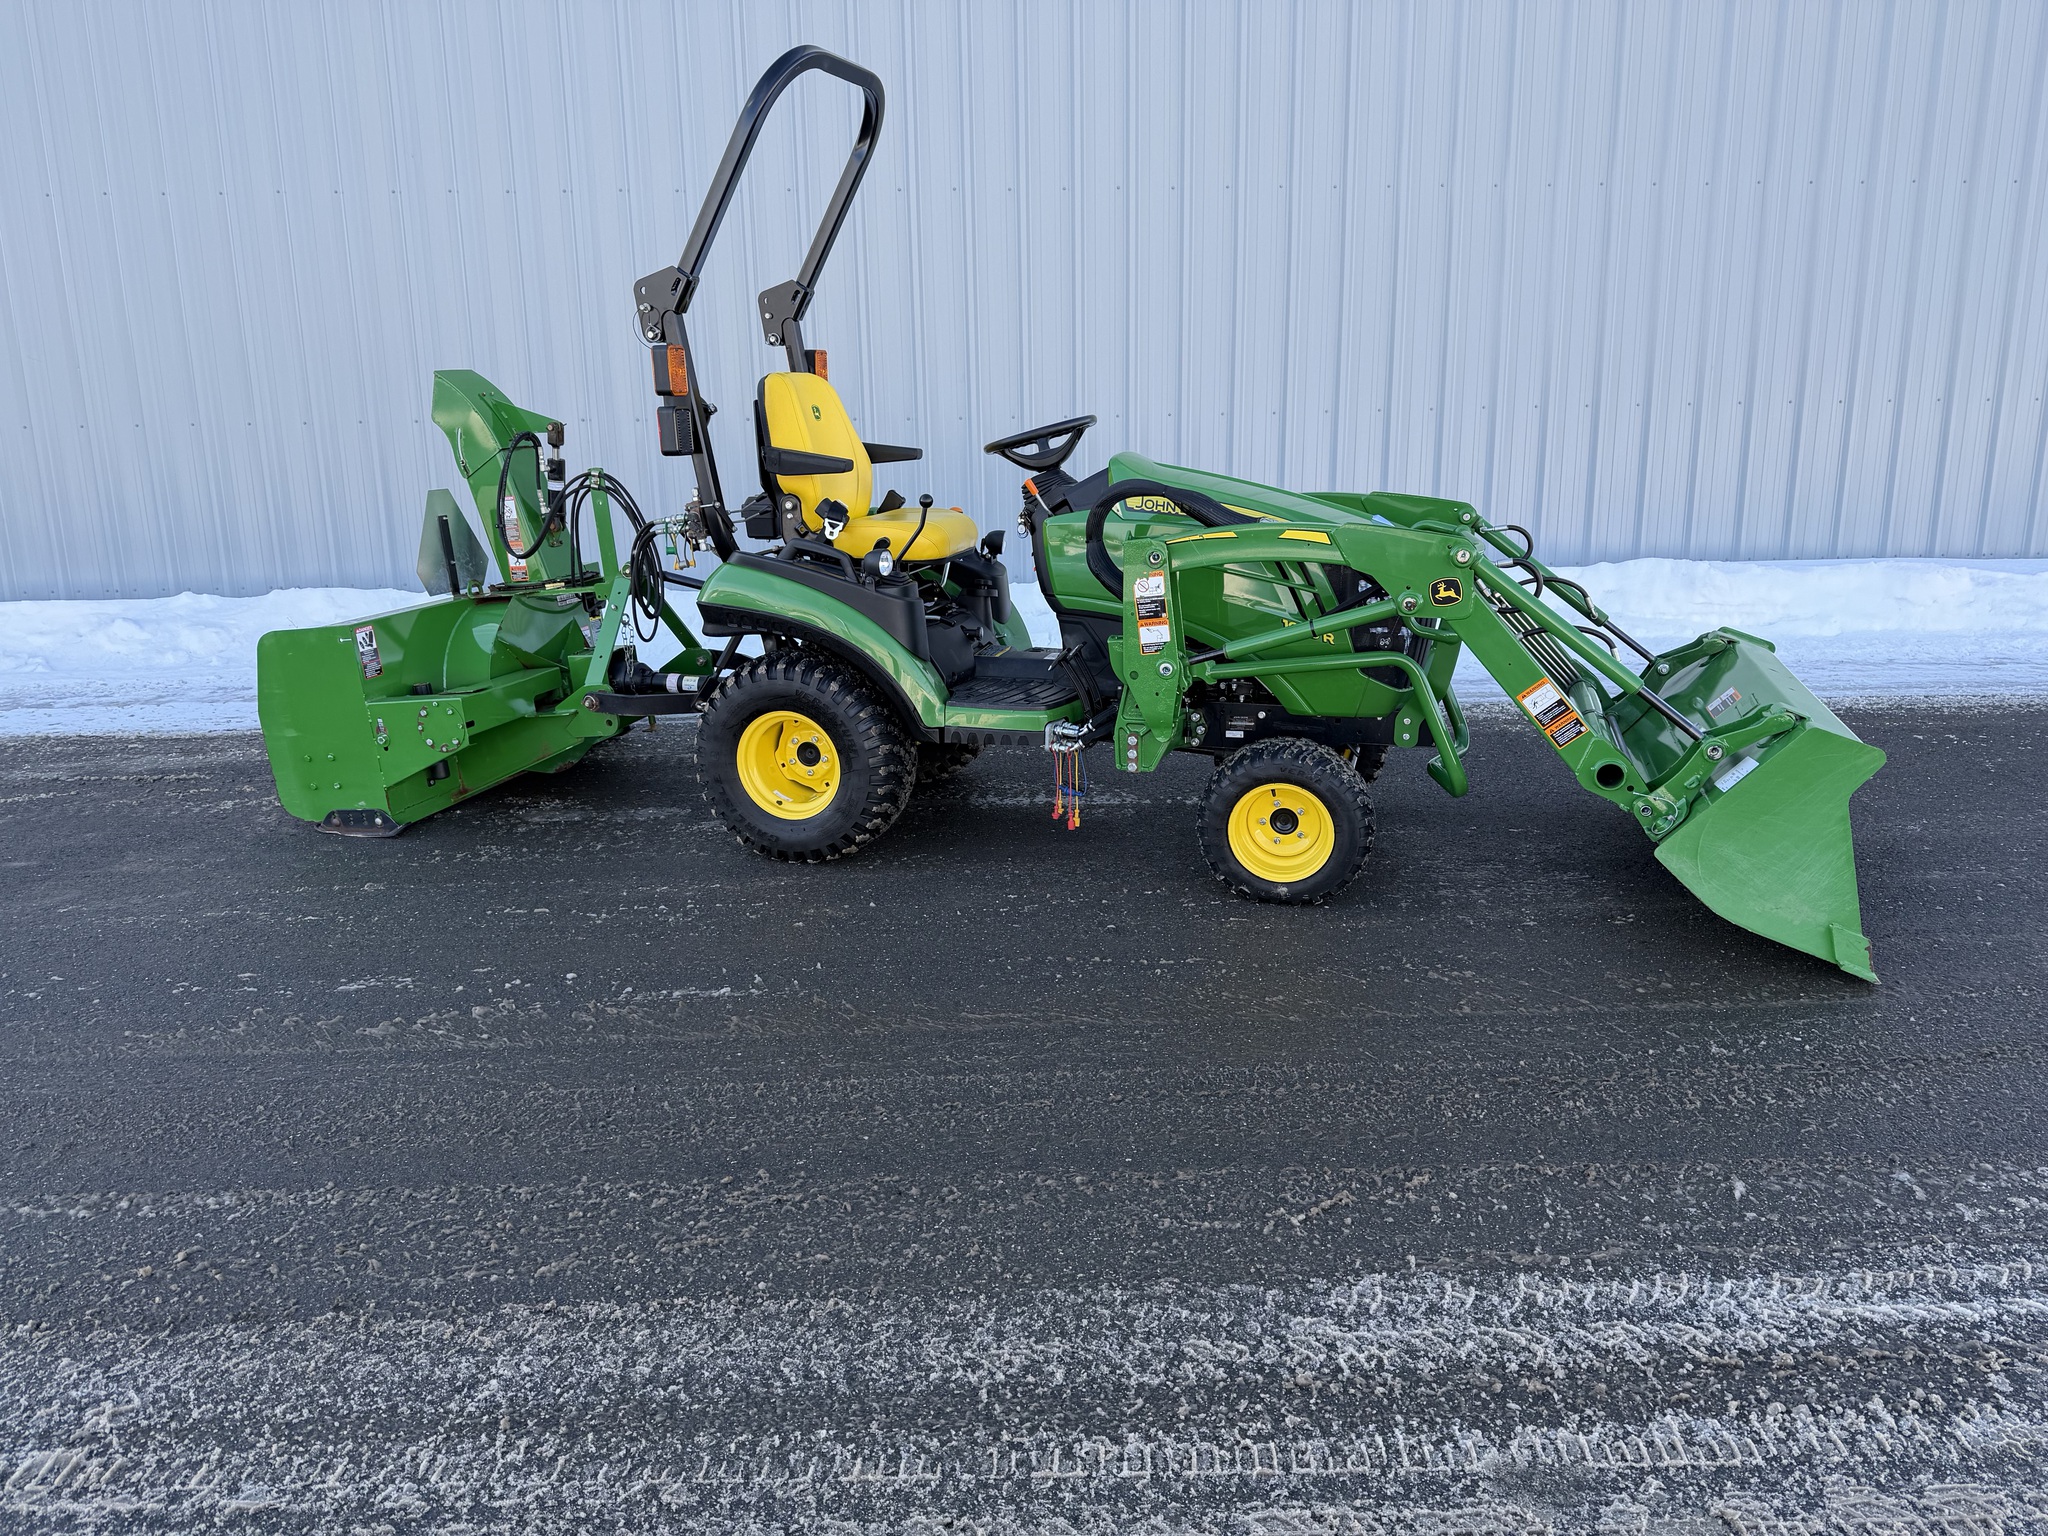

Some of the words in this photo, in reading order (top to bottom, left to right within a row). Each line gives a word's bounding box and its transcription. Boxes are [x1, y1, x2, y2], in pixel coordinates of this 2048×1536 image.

[1135, 496, 1176, 512] JOHN
[1526, 681, 1546, 695] WARNING
[1555, 715, 1575, 730] WARNING
